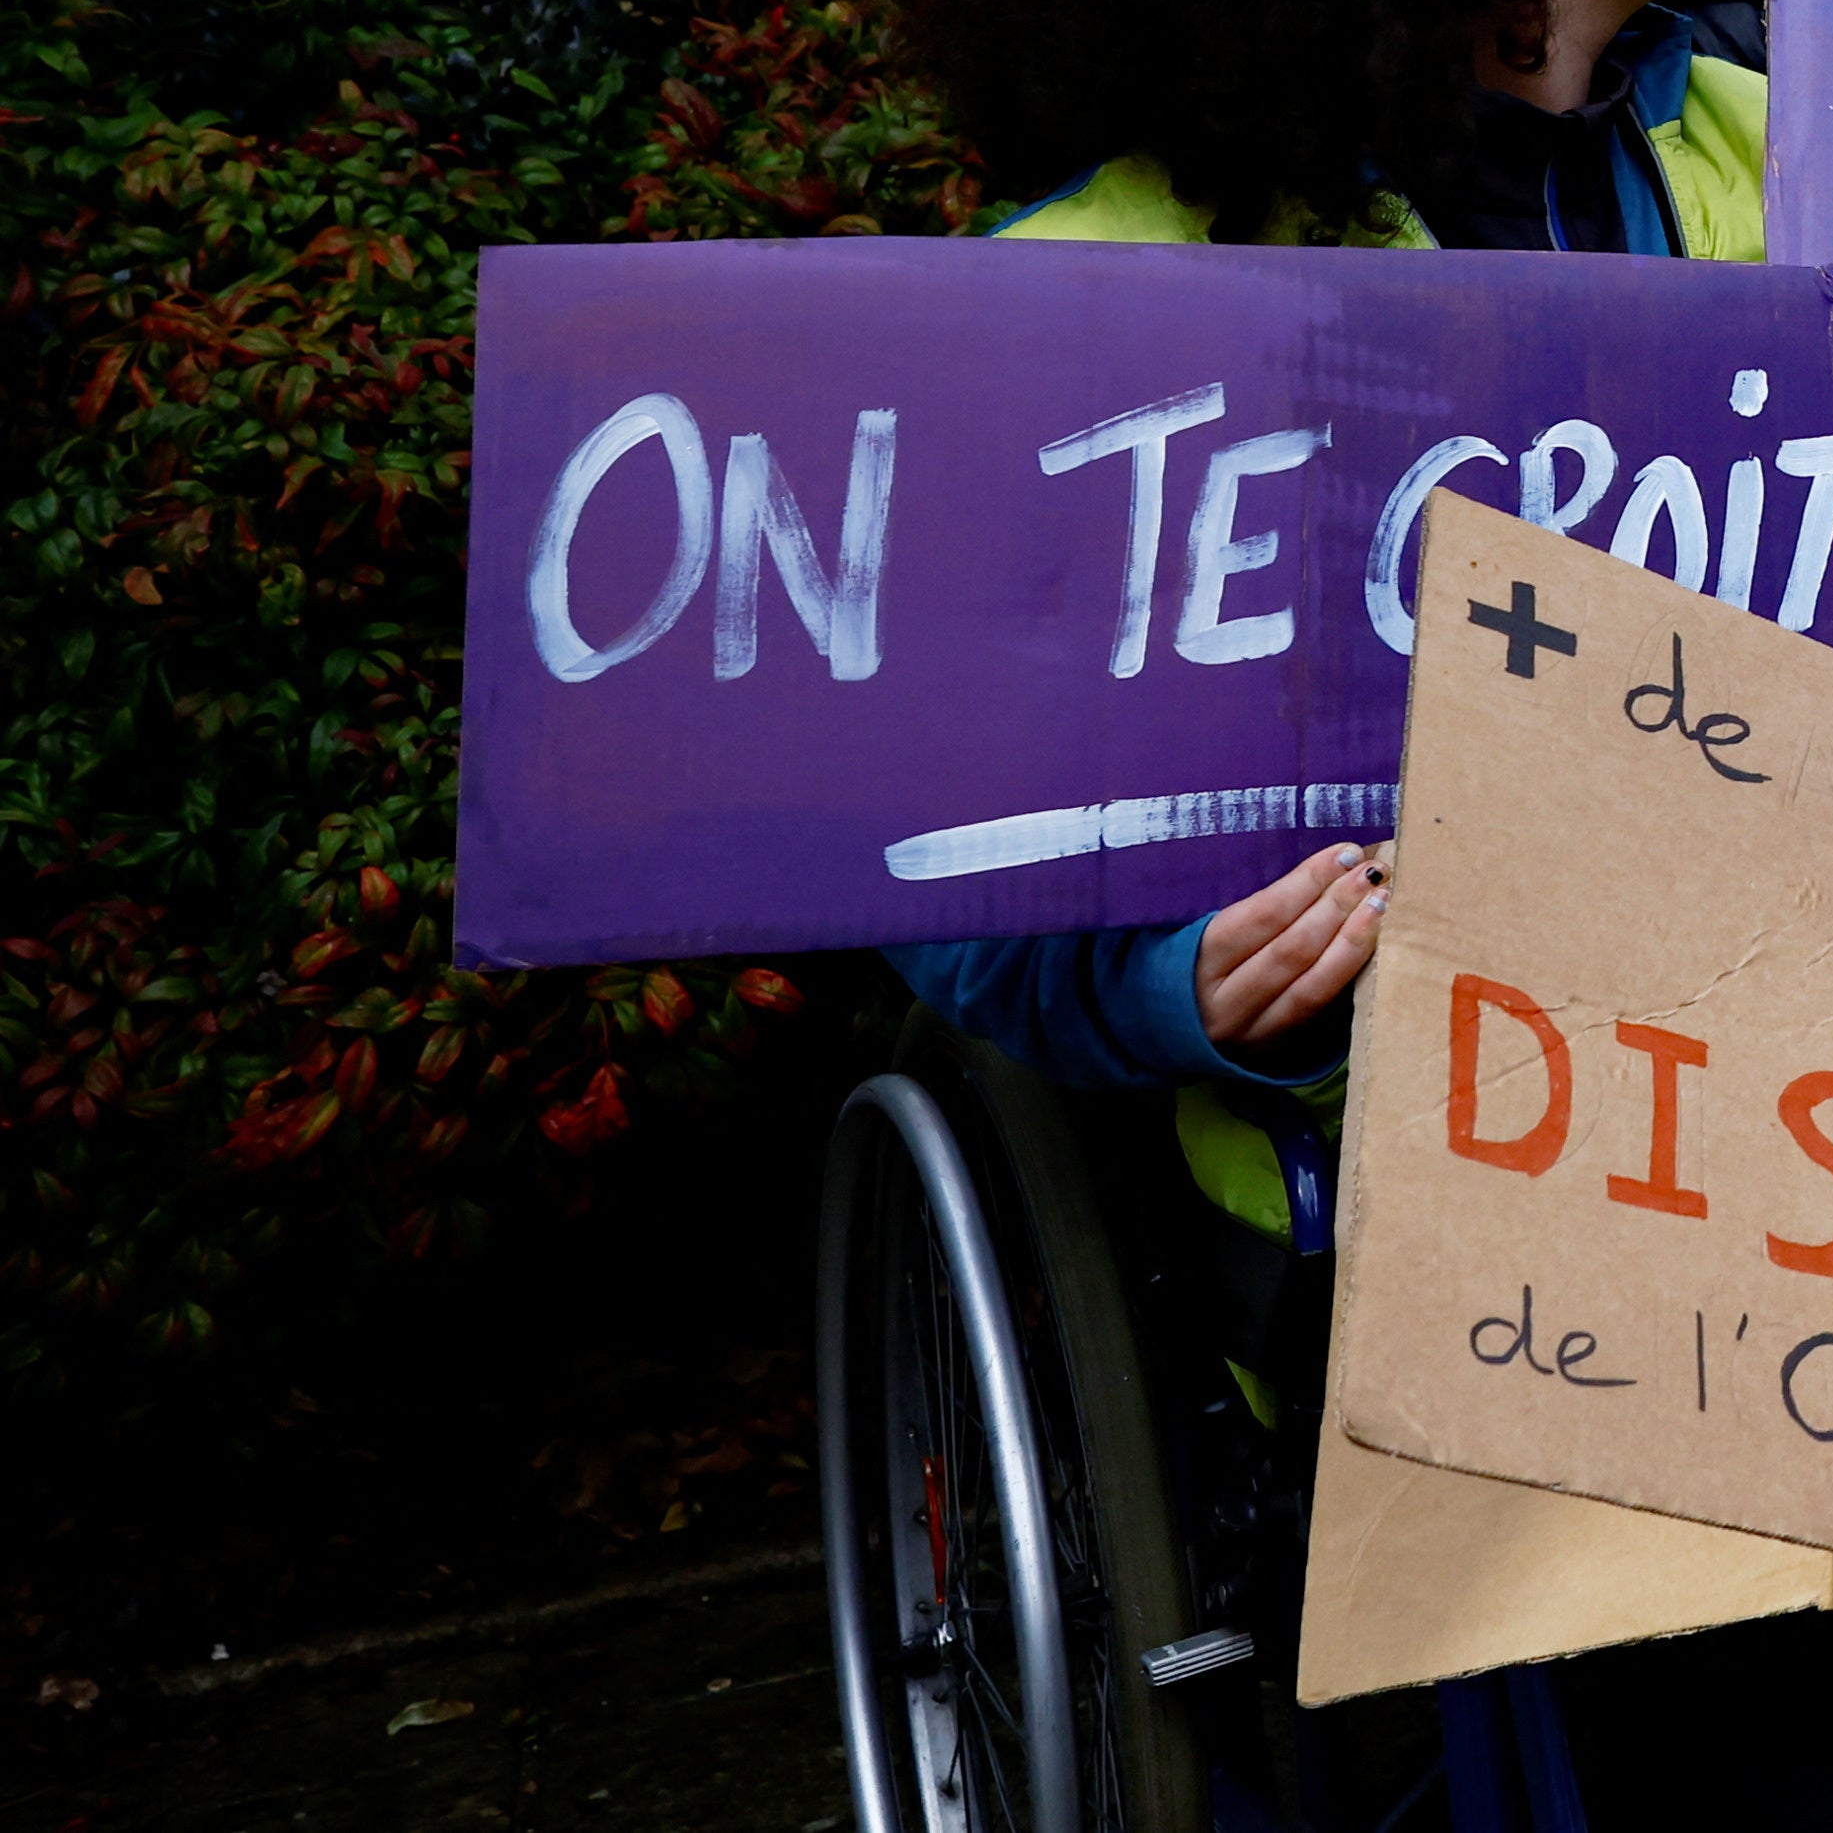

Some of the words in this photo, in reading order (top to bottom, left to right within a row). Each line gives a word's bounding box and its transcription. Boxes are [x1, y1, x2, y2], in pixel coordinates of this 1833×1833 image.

[529, 392, 897, 682] ON
[1040, 381, 1333, 680] TE
[1467, 581, 1577, 679] +
[1622, 632, 1771, 782] de
[1470, 1283, 1637, 1387] de
